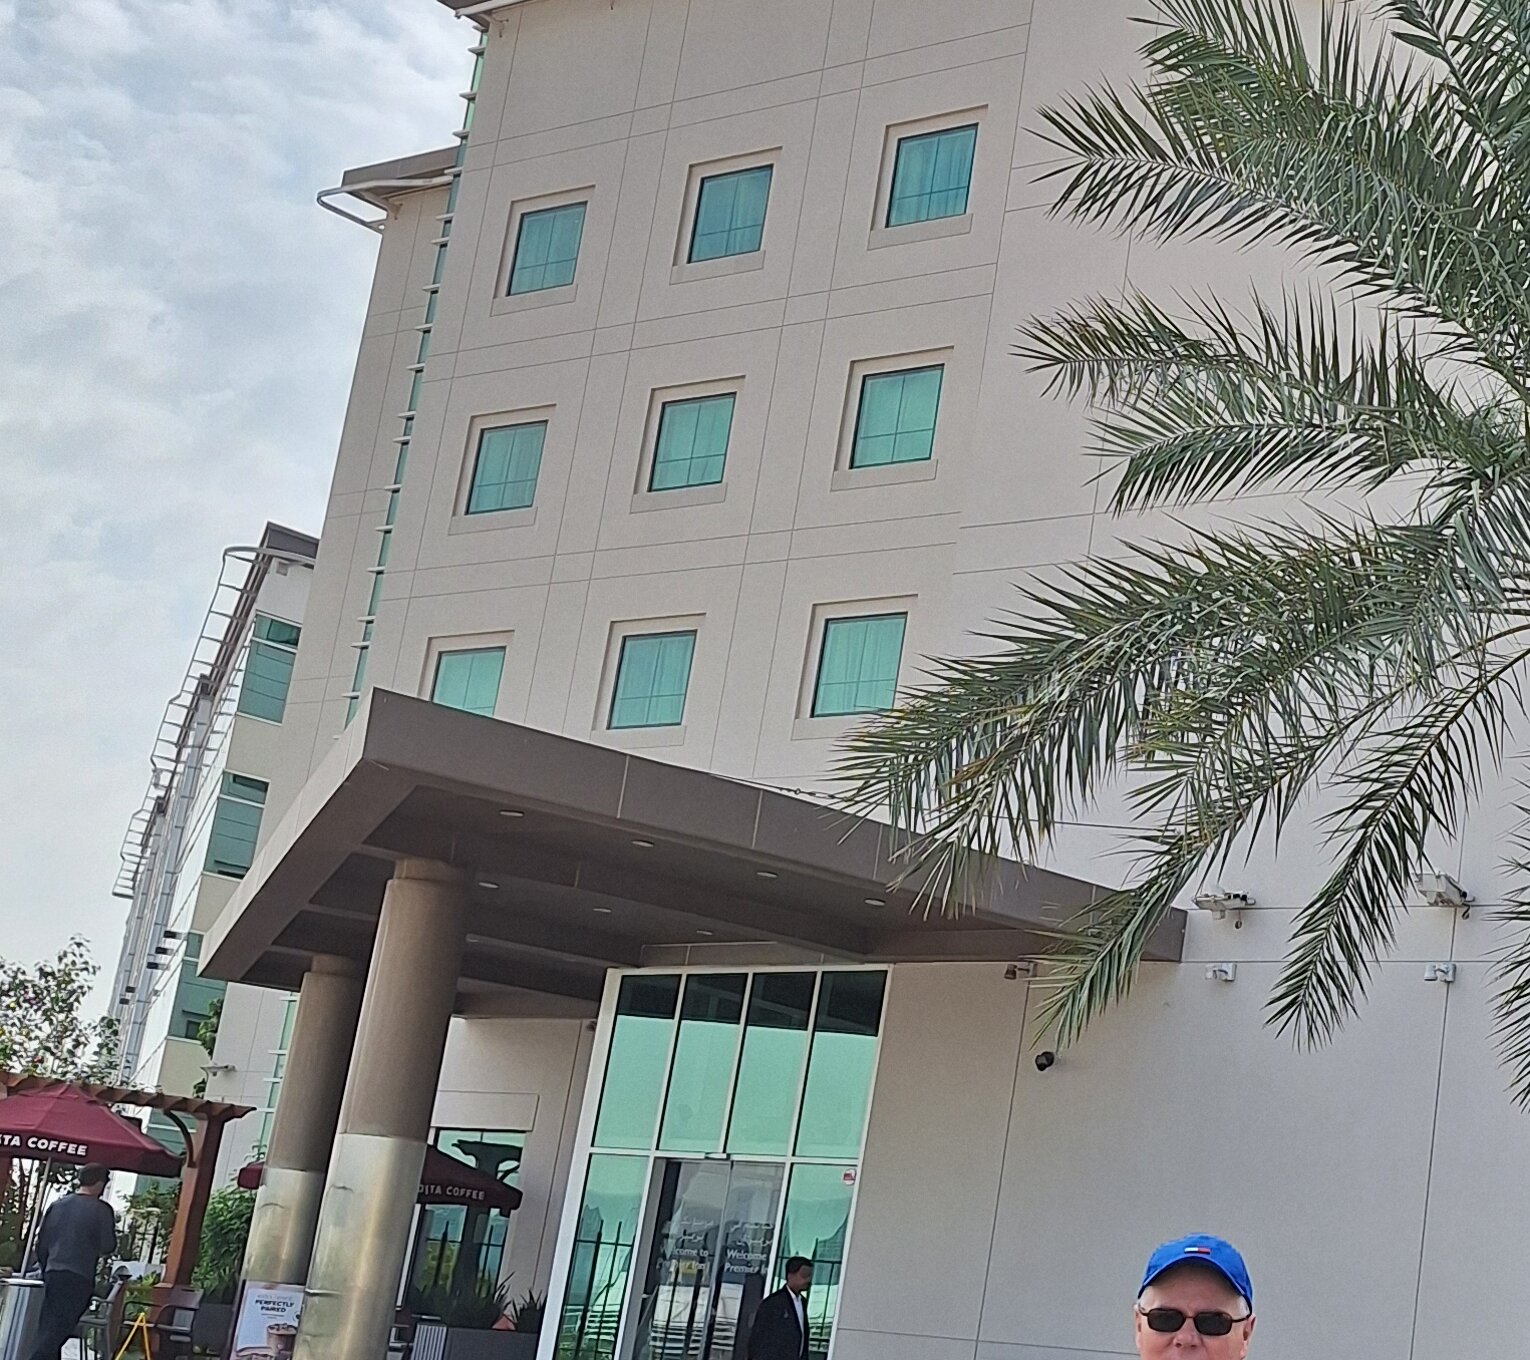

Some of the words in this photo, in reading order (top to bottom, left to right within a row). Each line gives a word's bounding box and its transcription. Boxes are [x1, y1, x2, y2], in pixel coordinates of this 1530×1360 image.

[0, 1133, 21, 1147] TA
[27, 1136, 88, 1156] COFFEE
[446, 1186, 485, 1200] COFFEE
[726, 1248, 768, 1261] Welcome
[724, 1261, 760, 1274] Premier
[255, 1299, 295, 1308] PERFECTLY
